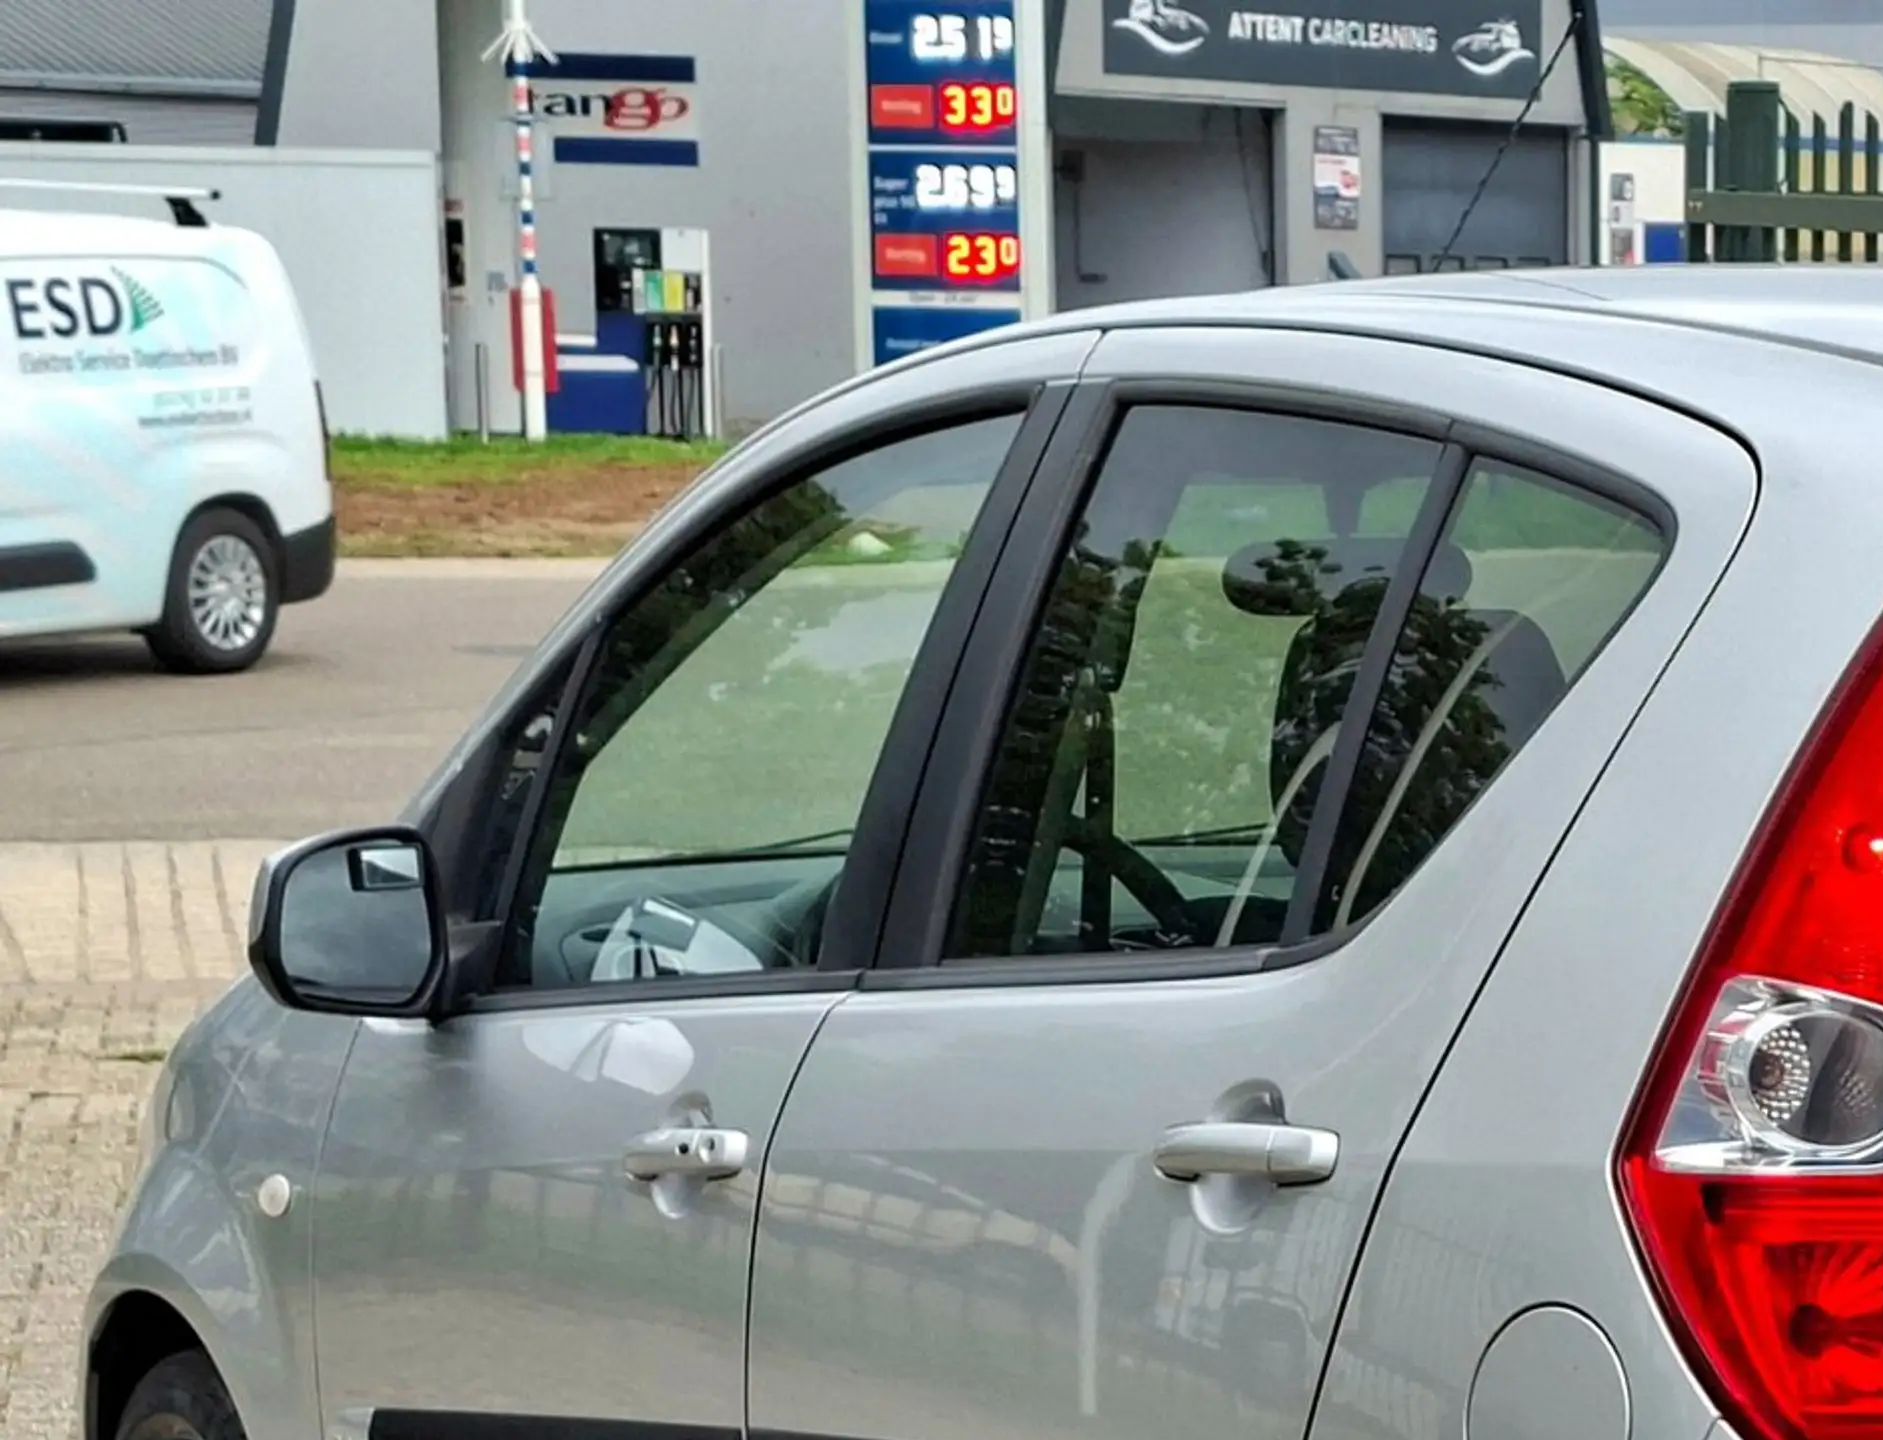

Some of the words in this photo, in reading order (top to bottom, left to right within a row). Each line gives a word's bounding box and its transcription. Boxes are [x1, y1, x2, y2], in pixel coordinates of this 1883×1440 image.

[1228, 11, 1304, 43] ATTENT
[1306, 17, 1439, 52] CARCLEANING
[526, 86, 690, 131] tango
[5, 277, 124, 338] ESD
